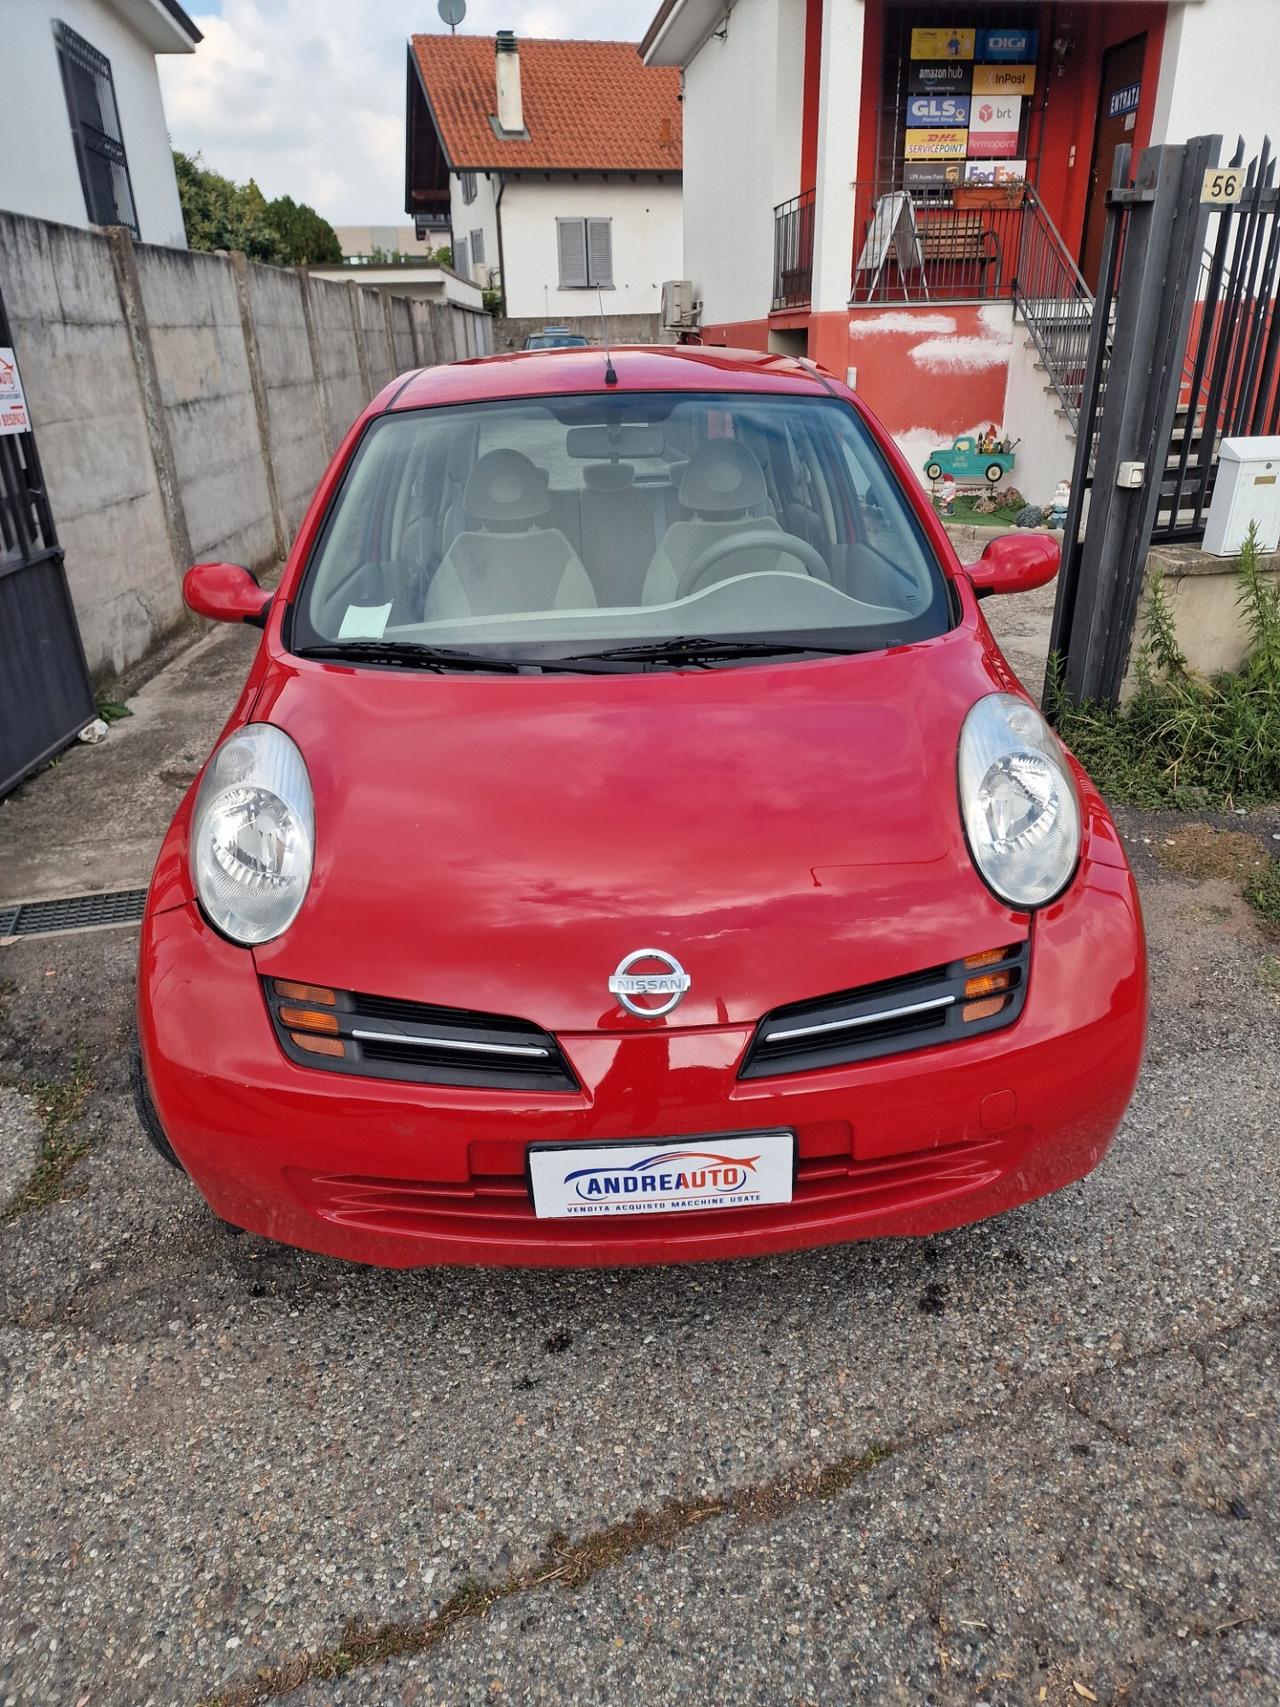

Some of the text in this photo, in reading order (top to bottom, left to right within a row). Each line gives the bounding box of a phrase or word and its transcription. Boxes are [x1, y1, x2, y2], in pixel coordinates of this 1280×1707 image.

[988, 37, 1026, 48] DIGI
[919, 65, 963, 79] amazon hub
[995, 73, 1026, 84] InPost
[1110, 86, 1140, 114] ENTRATA
[911, 100, 956, 116] GLS
[996, 107, 1012, 119] brt
[927, 134, 958, 142] DHL
[969, 139, 1016, 149] fermopoint
[908, 144, 963, 153] SERVICEPOINT
[969, 166, 1016, 182] FedEx
[1211, 175, 1237, 197] 56
[617, 978, 682, 991] NISSAN
[587, 1167, 738, 1195] ANDREAUTO
[567, 1194, 762, 1213] VENDITA ACQUISTO MACCHINE USATE
